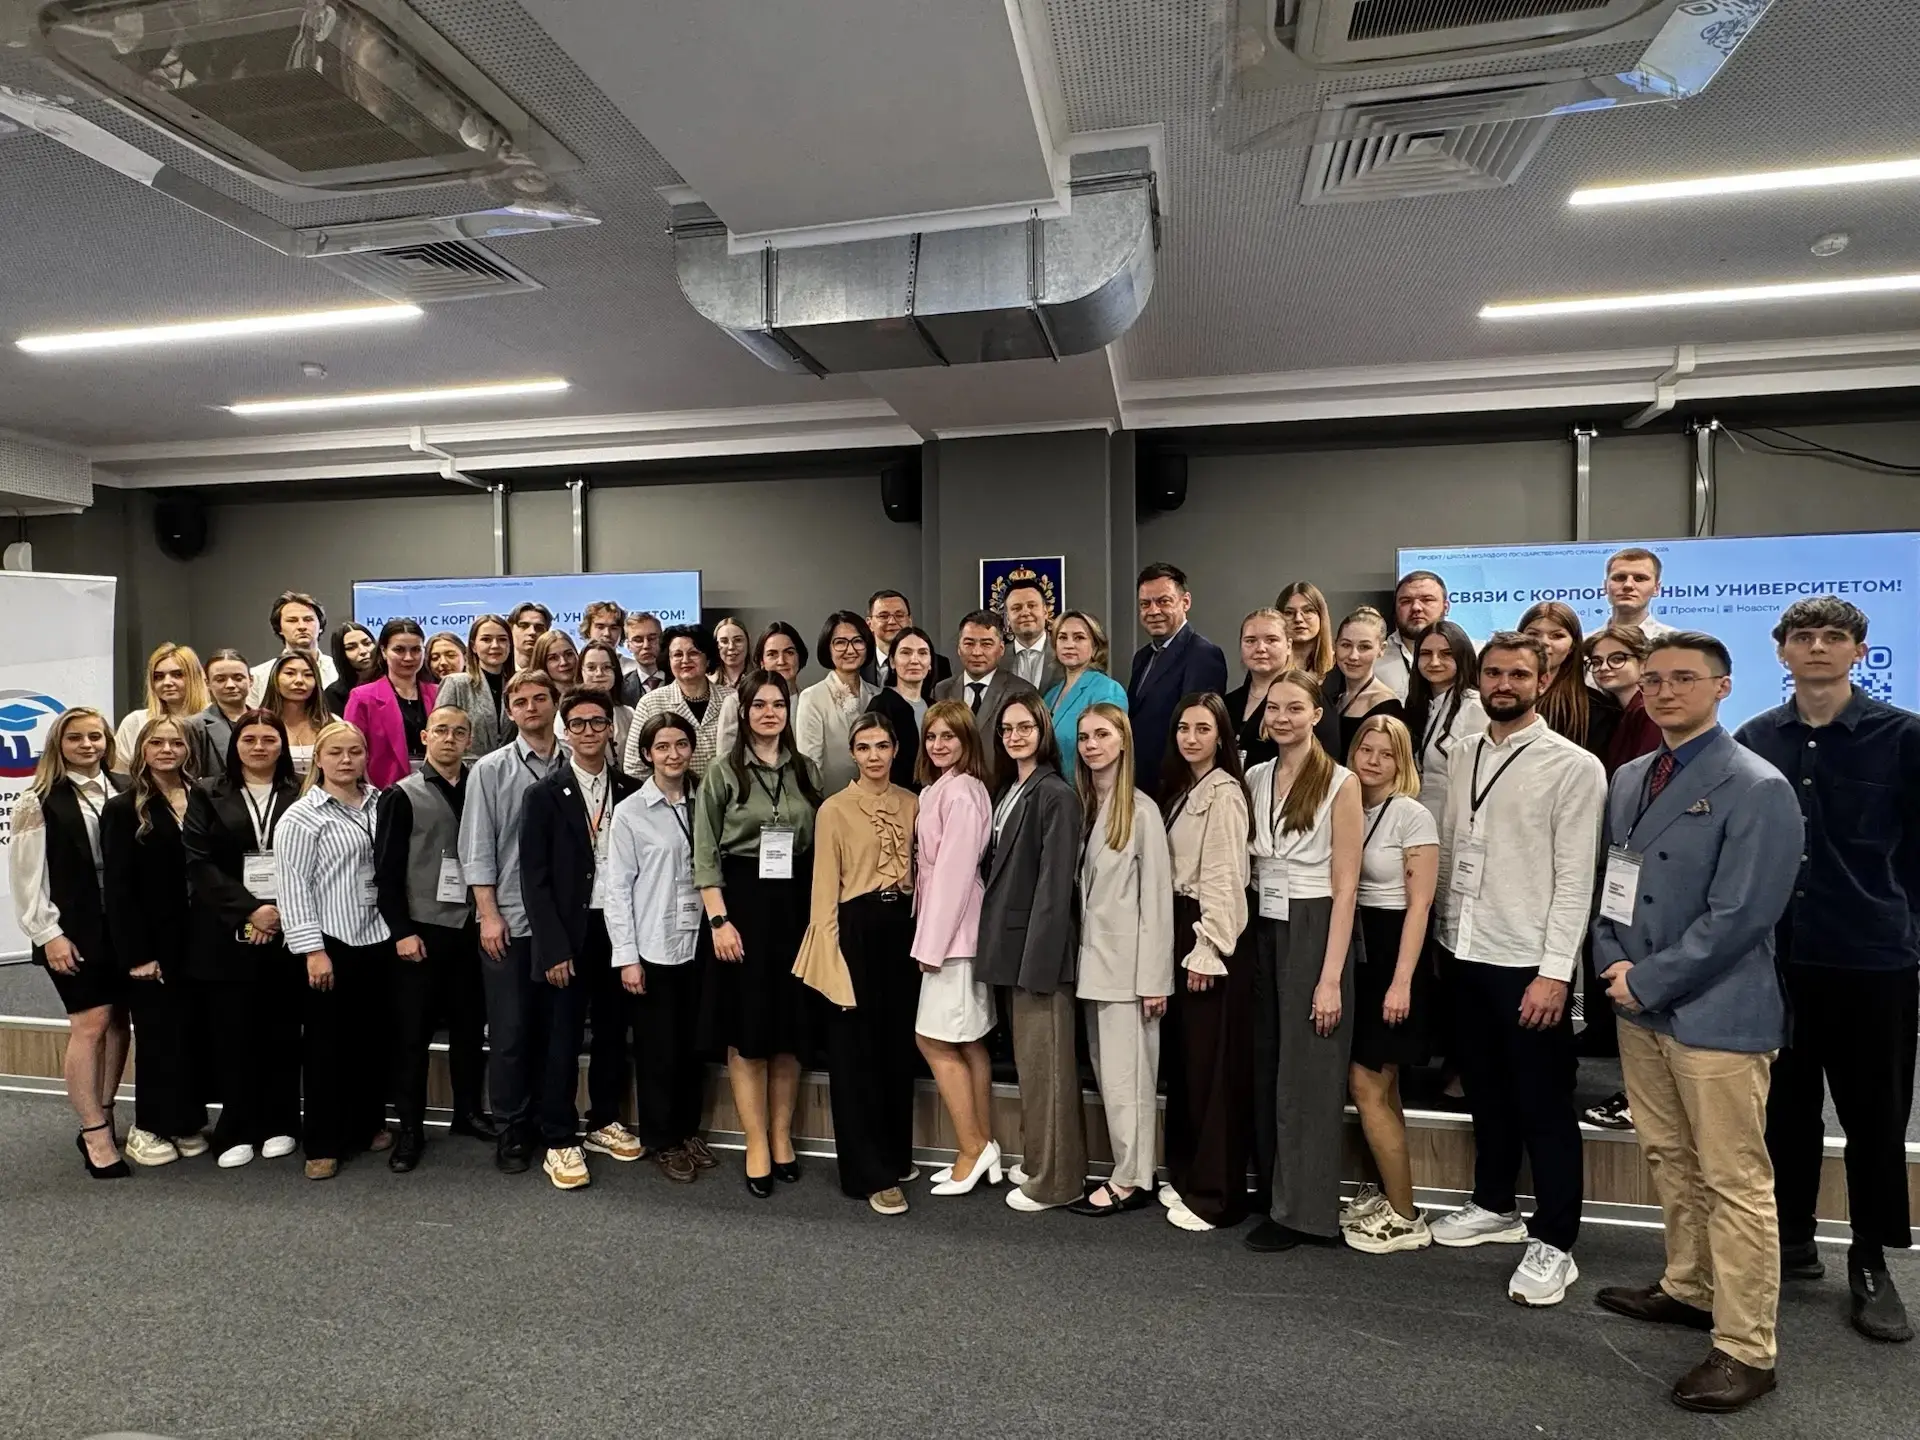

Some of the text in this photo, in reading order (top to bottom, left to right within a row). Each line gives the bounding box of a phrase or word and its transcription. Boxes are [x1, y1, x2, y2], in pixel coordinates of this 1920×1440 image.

[1449, 590, 1508, 604] СВЯЗИ
[1513, 589, 1525, 602] С
[1715, 579, 1903, 597] УНИВЕРСИТЕТОМ!
[1670, 604, 1780, 615] Проекты Новости
[366, 617, 384, 627] НА
[430, 616, 438, 626] С
